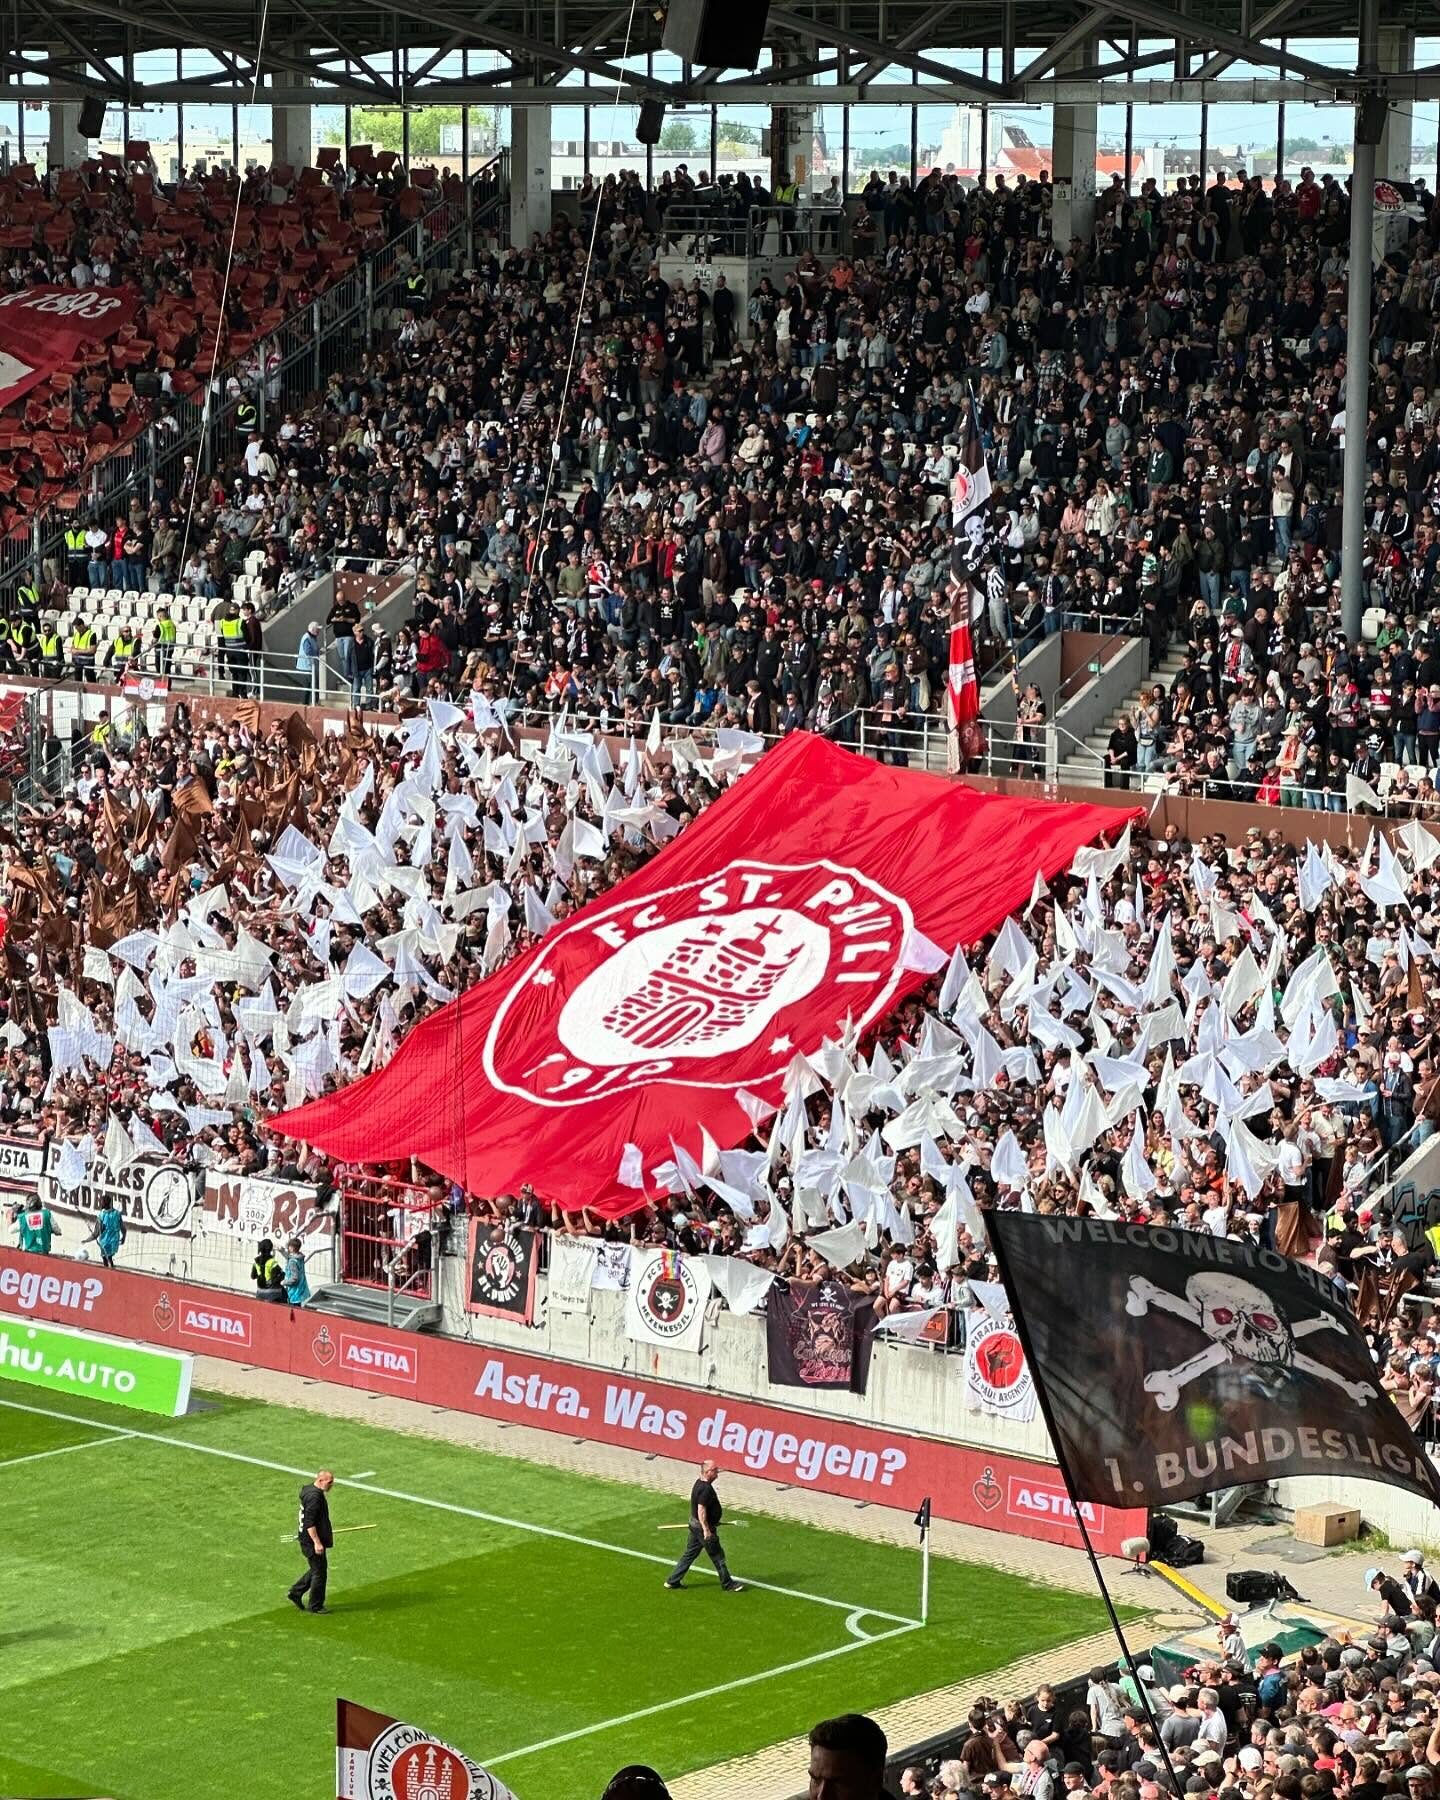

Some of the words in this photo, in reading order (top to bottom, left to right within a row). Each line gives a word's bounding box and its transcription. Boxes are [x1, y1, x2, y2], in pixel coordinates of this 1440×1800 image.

[20, 291, 121, 318] 1893
[593, 904, 665, 949] FC
[698, 873, 781, 911] ST.
[804, 879, 892, 983] PAULI
[521, 1053, 674, 1093] 1910
[51, 1147, 145, 1190] PPPERS
[1040, 1219, 1233, 1264] WELCOME
[1240, 1247, 1288, 1272] TO
[647, 1268, 656, 1280] FC
[185, 1309, 245, 1338] ASTRA
[642, 1305, 690, 1333] HEXENKESSEL
[971, 1321, 1006, 1348] PIRATAS
[345, 1344, 410, 1374] ASTRA
[474, 1360, 590, 1419] Astra.
[604, 1385, 688, 1440] Was
[697, 1408, 908, 1486] dagegen?
[1104, 1458, 1144, 1492] 1.
[1154, 1427, 1434, 1490] BUNDESLIGA
[1016, 1488, 1096, 1522] ASTRA
